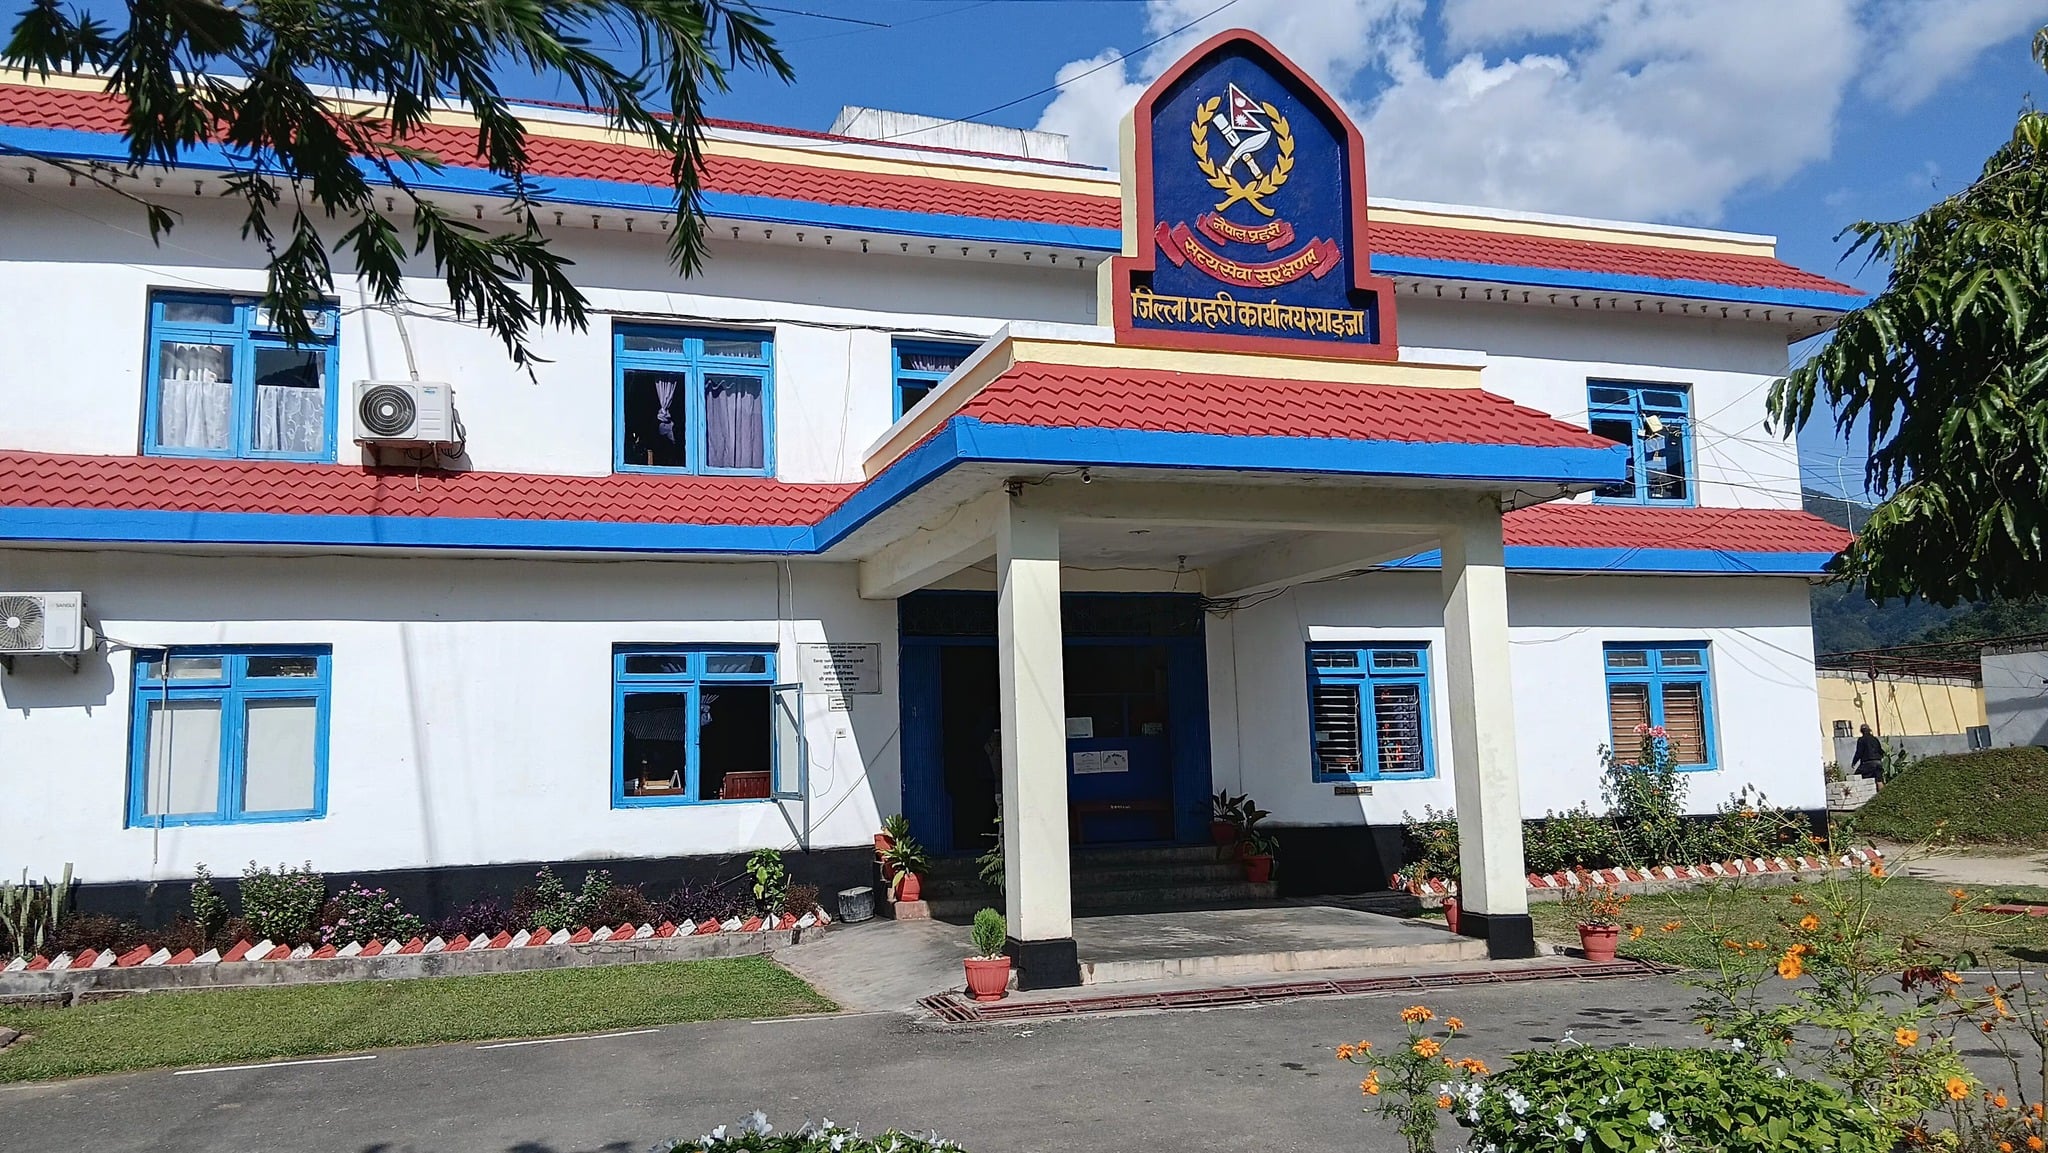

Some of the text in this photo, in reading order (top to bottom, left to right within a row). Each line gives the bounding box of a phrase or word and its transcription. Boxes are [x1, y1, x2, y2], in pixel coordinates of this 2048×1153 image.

[1213, 217, 1280, 242] नेपाल प्रहरी
[1185, 236, 1319, 286] सत्य सेवा सुरक्षणम्
[1131, 285, 1187, 323] जिल्ला
[1188, 291, 1236, 328] प्रहरी
[1237, 298, 1306, 332] कार्यालय
